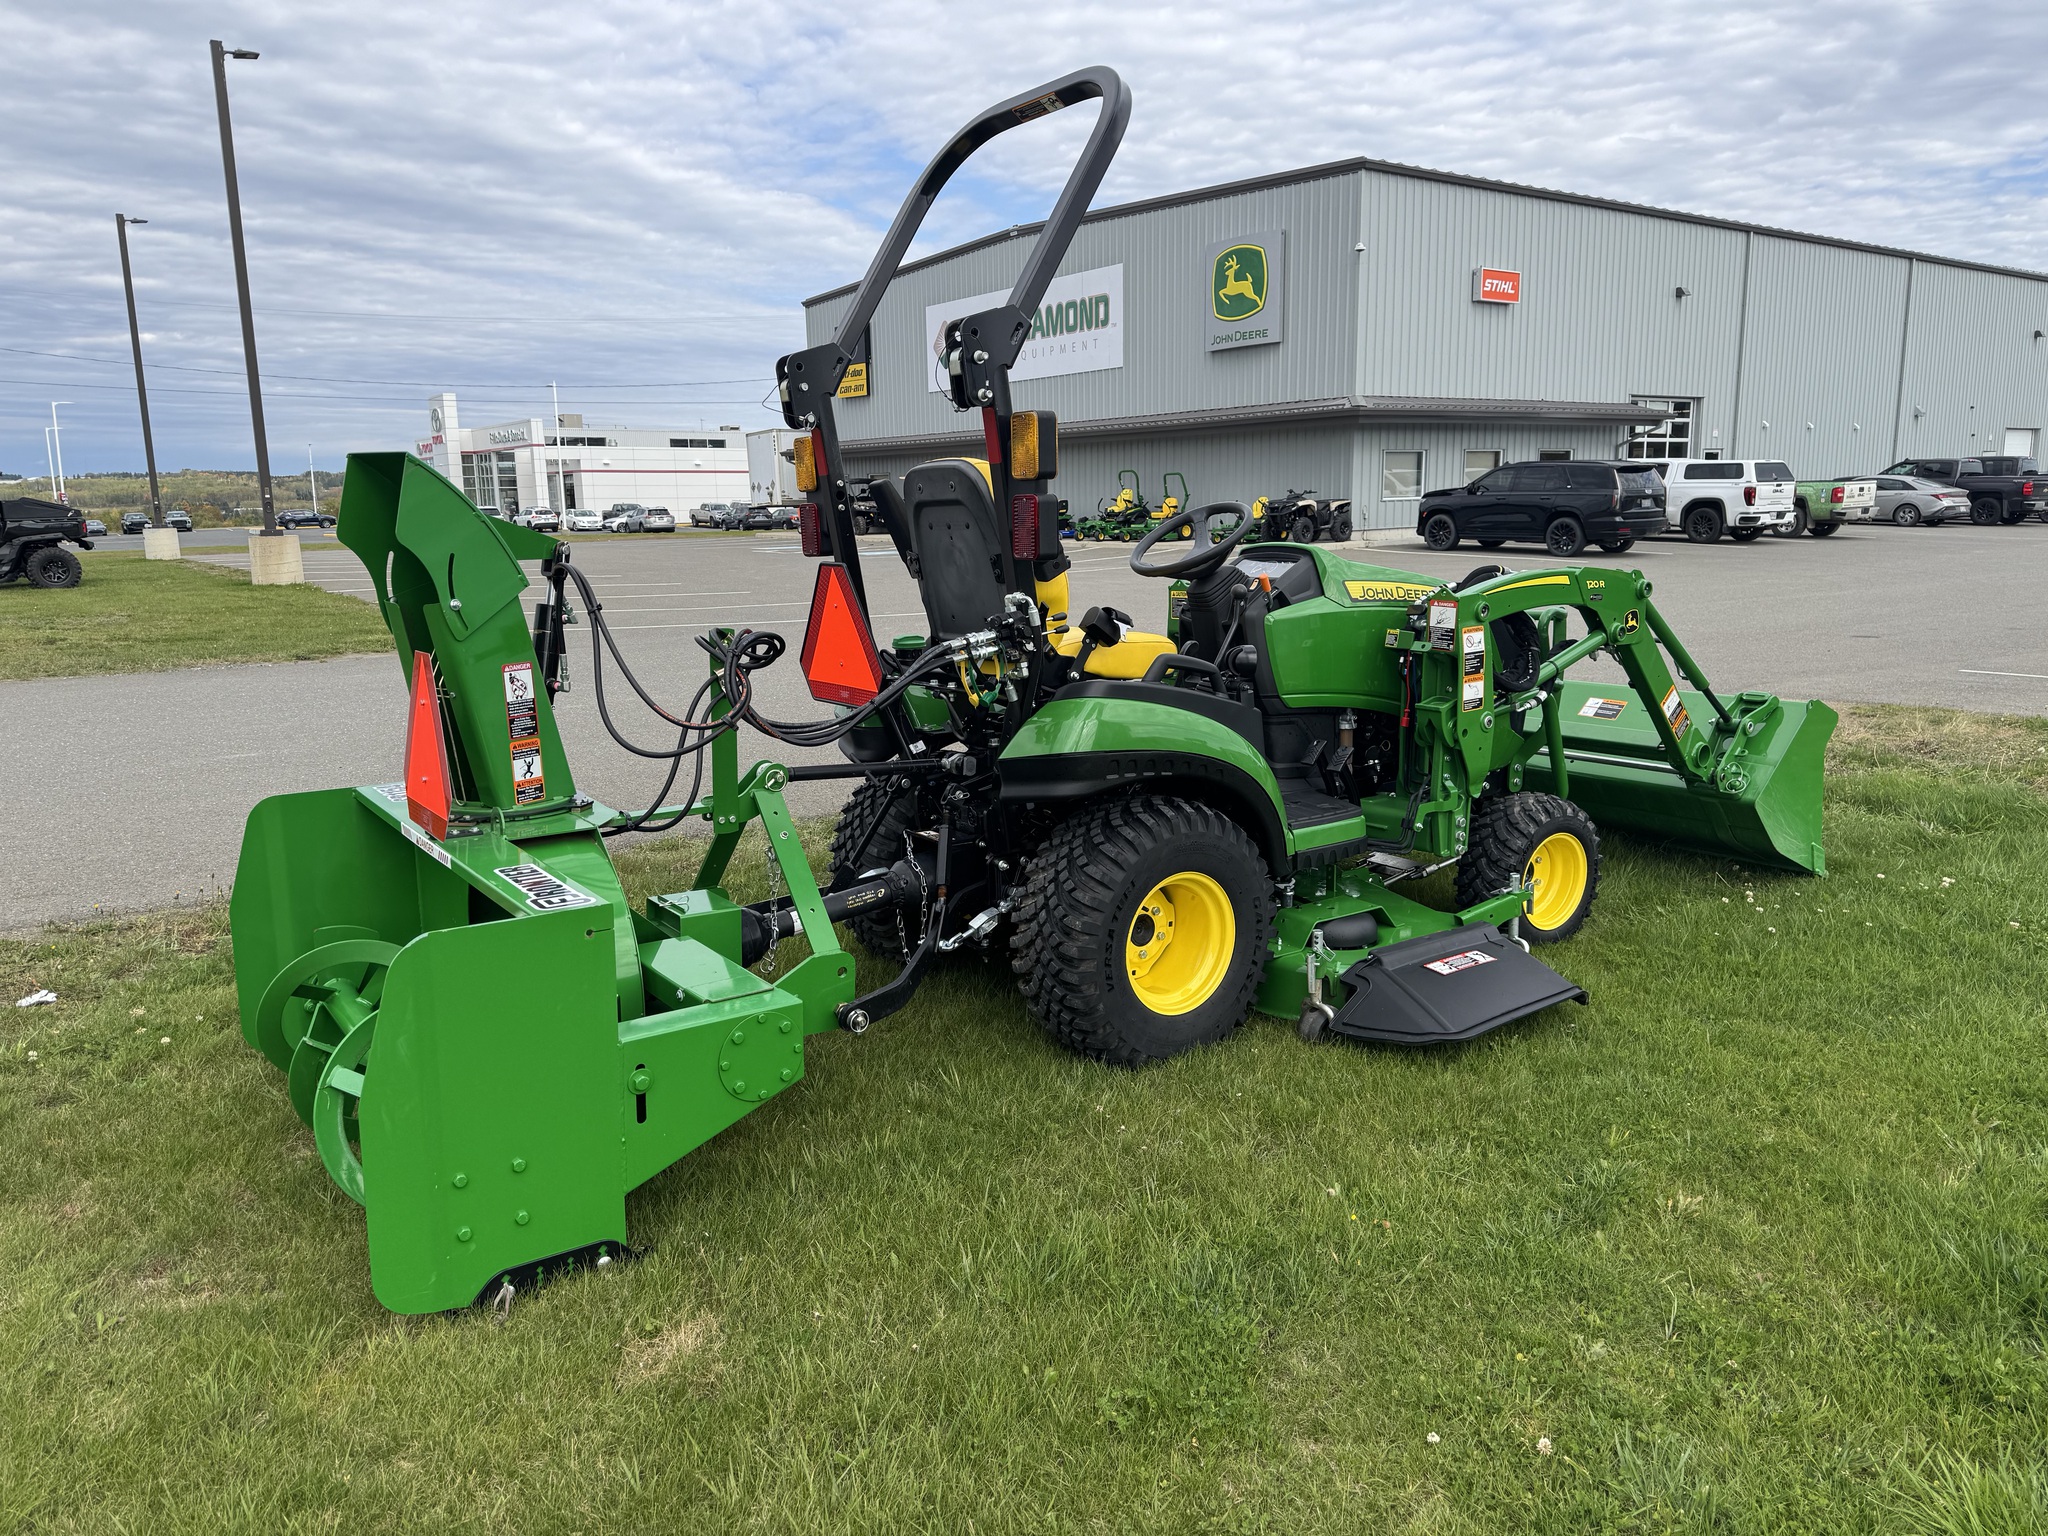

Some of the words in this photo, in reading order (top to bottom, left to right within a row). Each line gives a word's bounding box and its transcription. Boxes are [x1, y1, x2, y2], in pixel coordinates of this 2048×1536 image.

[1484, 279, 1515, 294] STIHL
[1026, 294, 1110, 341] AMOND
[1211, 334, 1234, 346] JOHN
[1234, 329, 1269, 342] DEERE
[1021, 339, 1098, 360] QUIPMENT
[844, 368, 863, 379] i-doo
[840, 384, 864, 394] can-am
[1358, 586, 1394, 599] JOHN
[1395, 586, 1433, 599] DEER
[508, 663, 532, 672] DANGER
[516, 740, 539, 749] WARNING
[1105, 928, 1116, 993] VERSA
